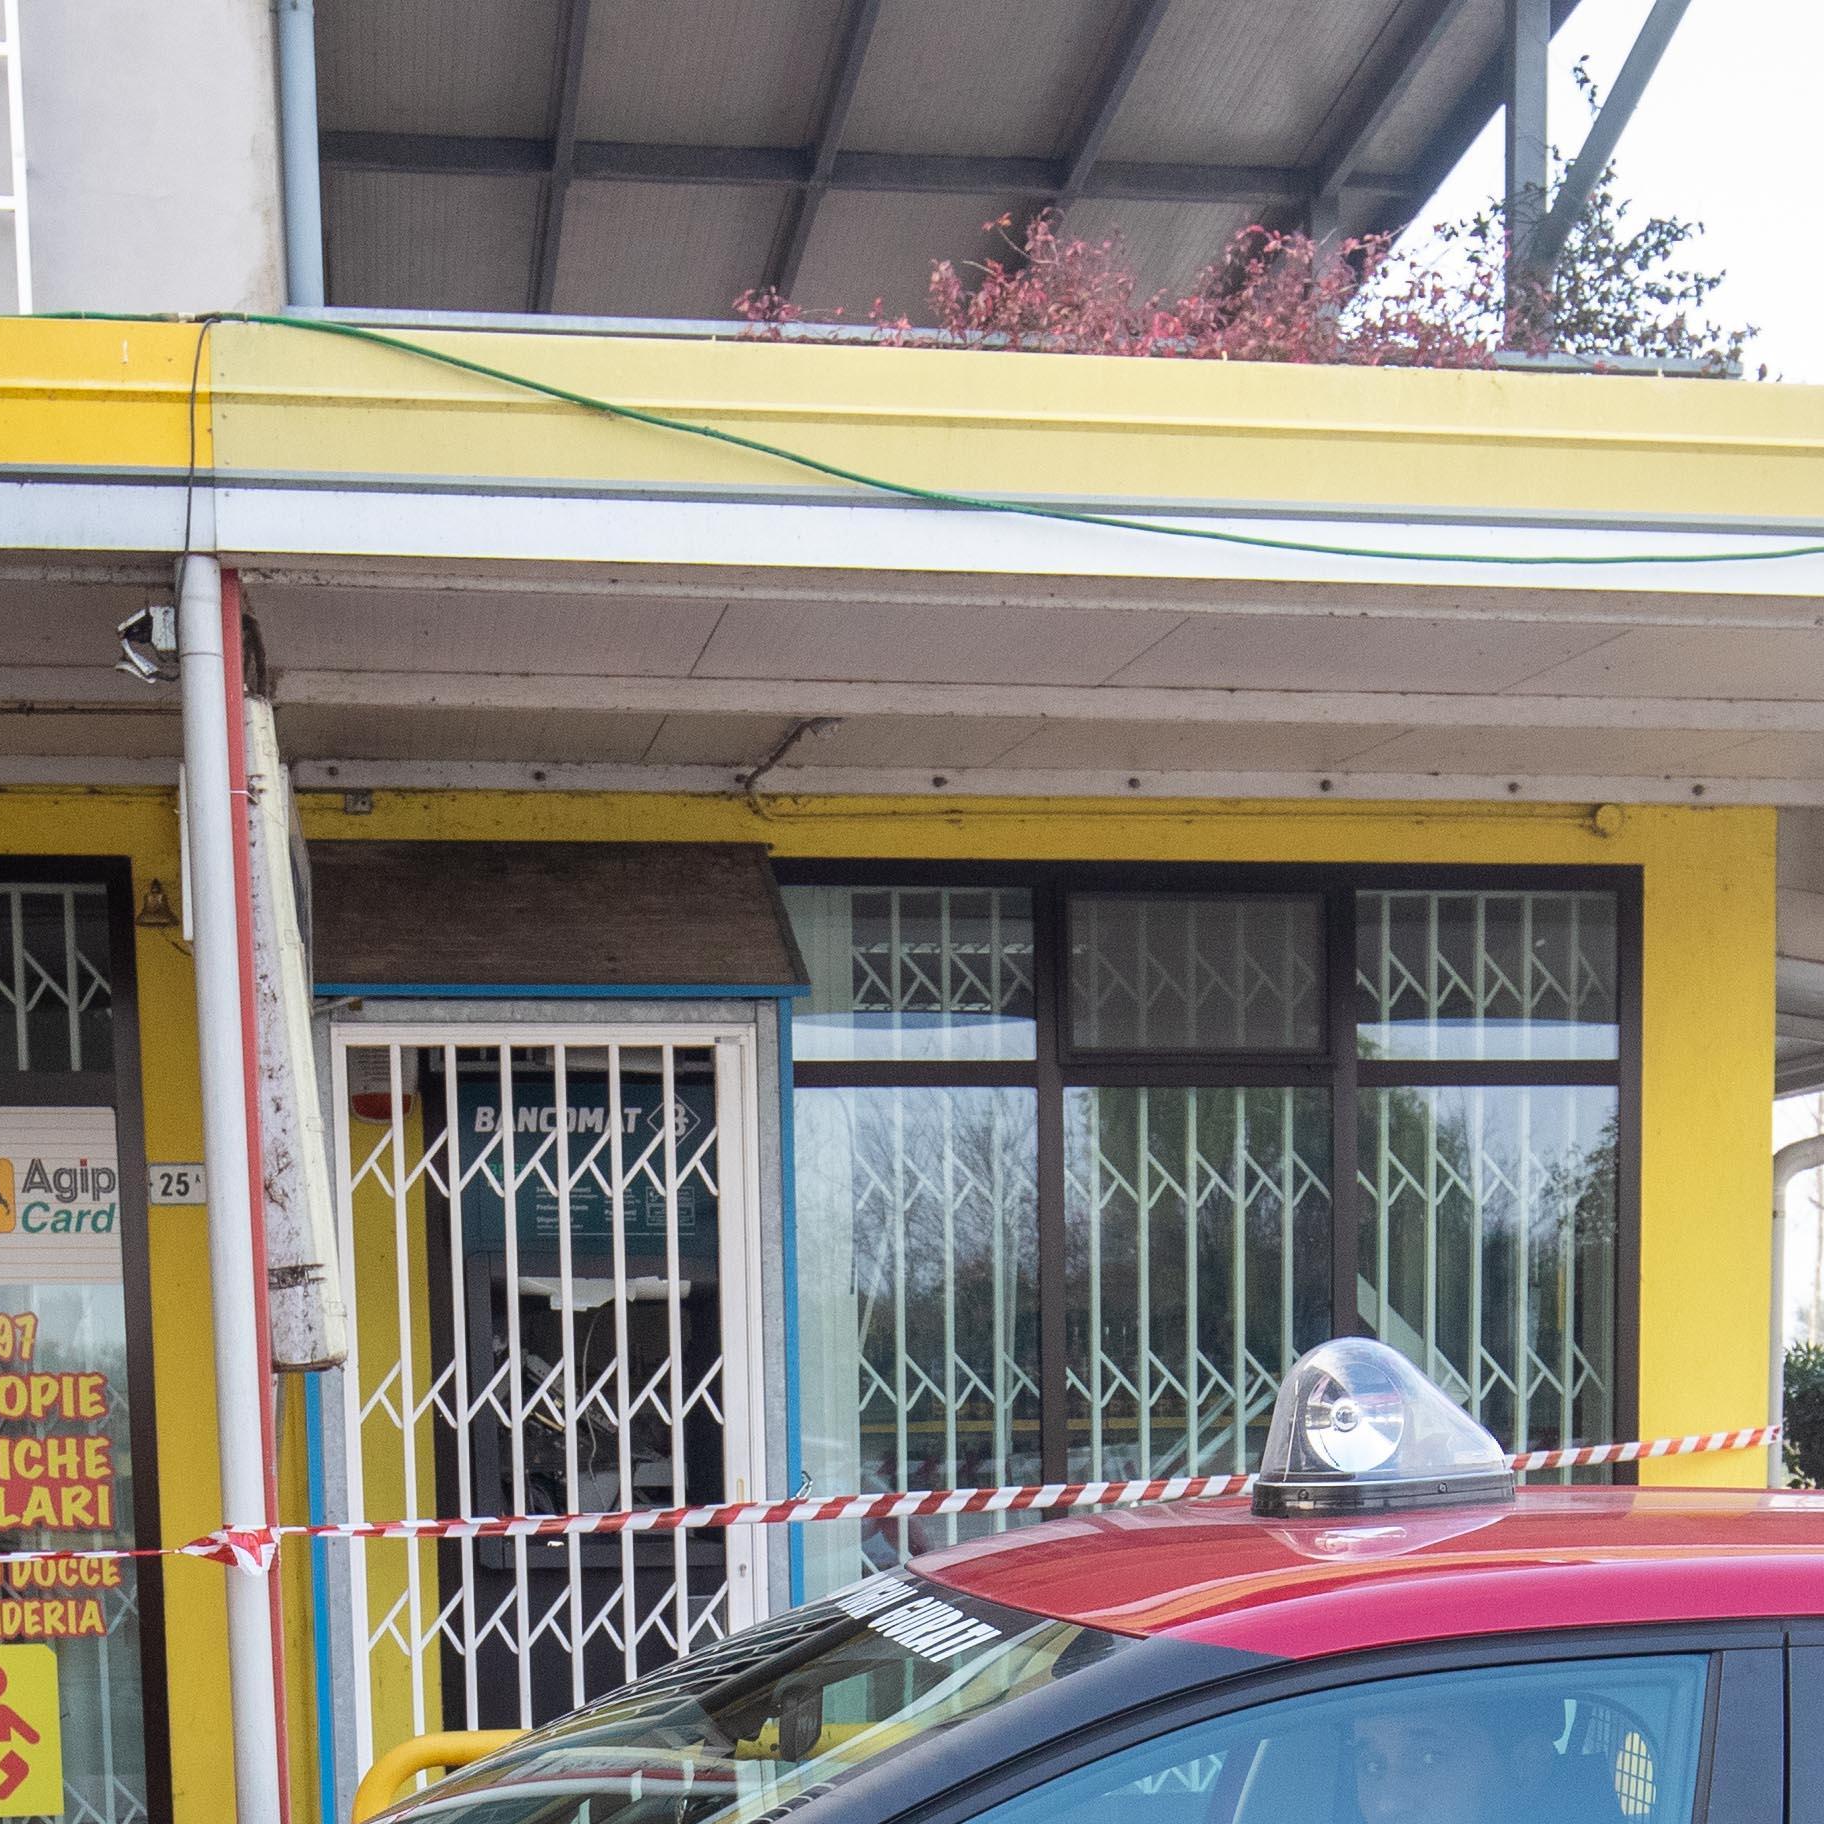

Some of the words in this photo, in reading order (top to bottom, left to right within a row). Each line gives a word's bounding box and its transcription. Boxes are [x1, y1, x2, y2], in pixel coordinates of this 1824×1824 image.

[21, 1157, 117, 1202] Agip
[160, 1172, 190, 1197] 25
[21, 1201, 116, 1234] Card
[11, 1557, 122, 1589] DOCCE
[867, 1596, 1003, 1663] GIURATI
